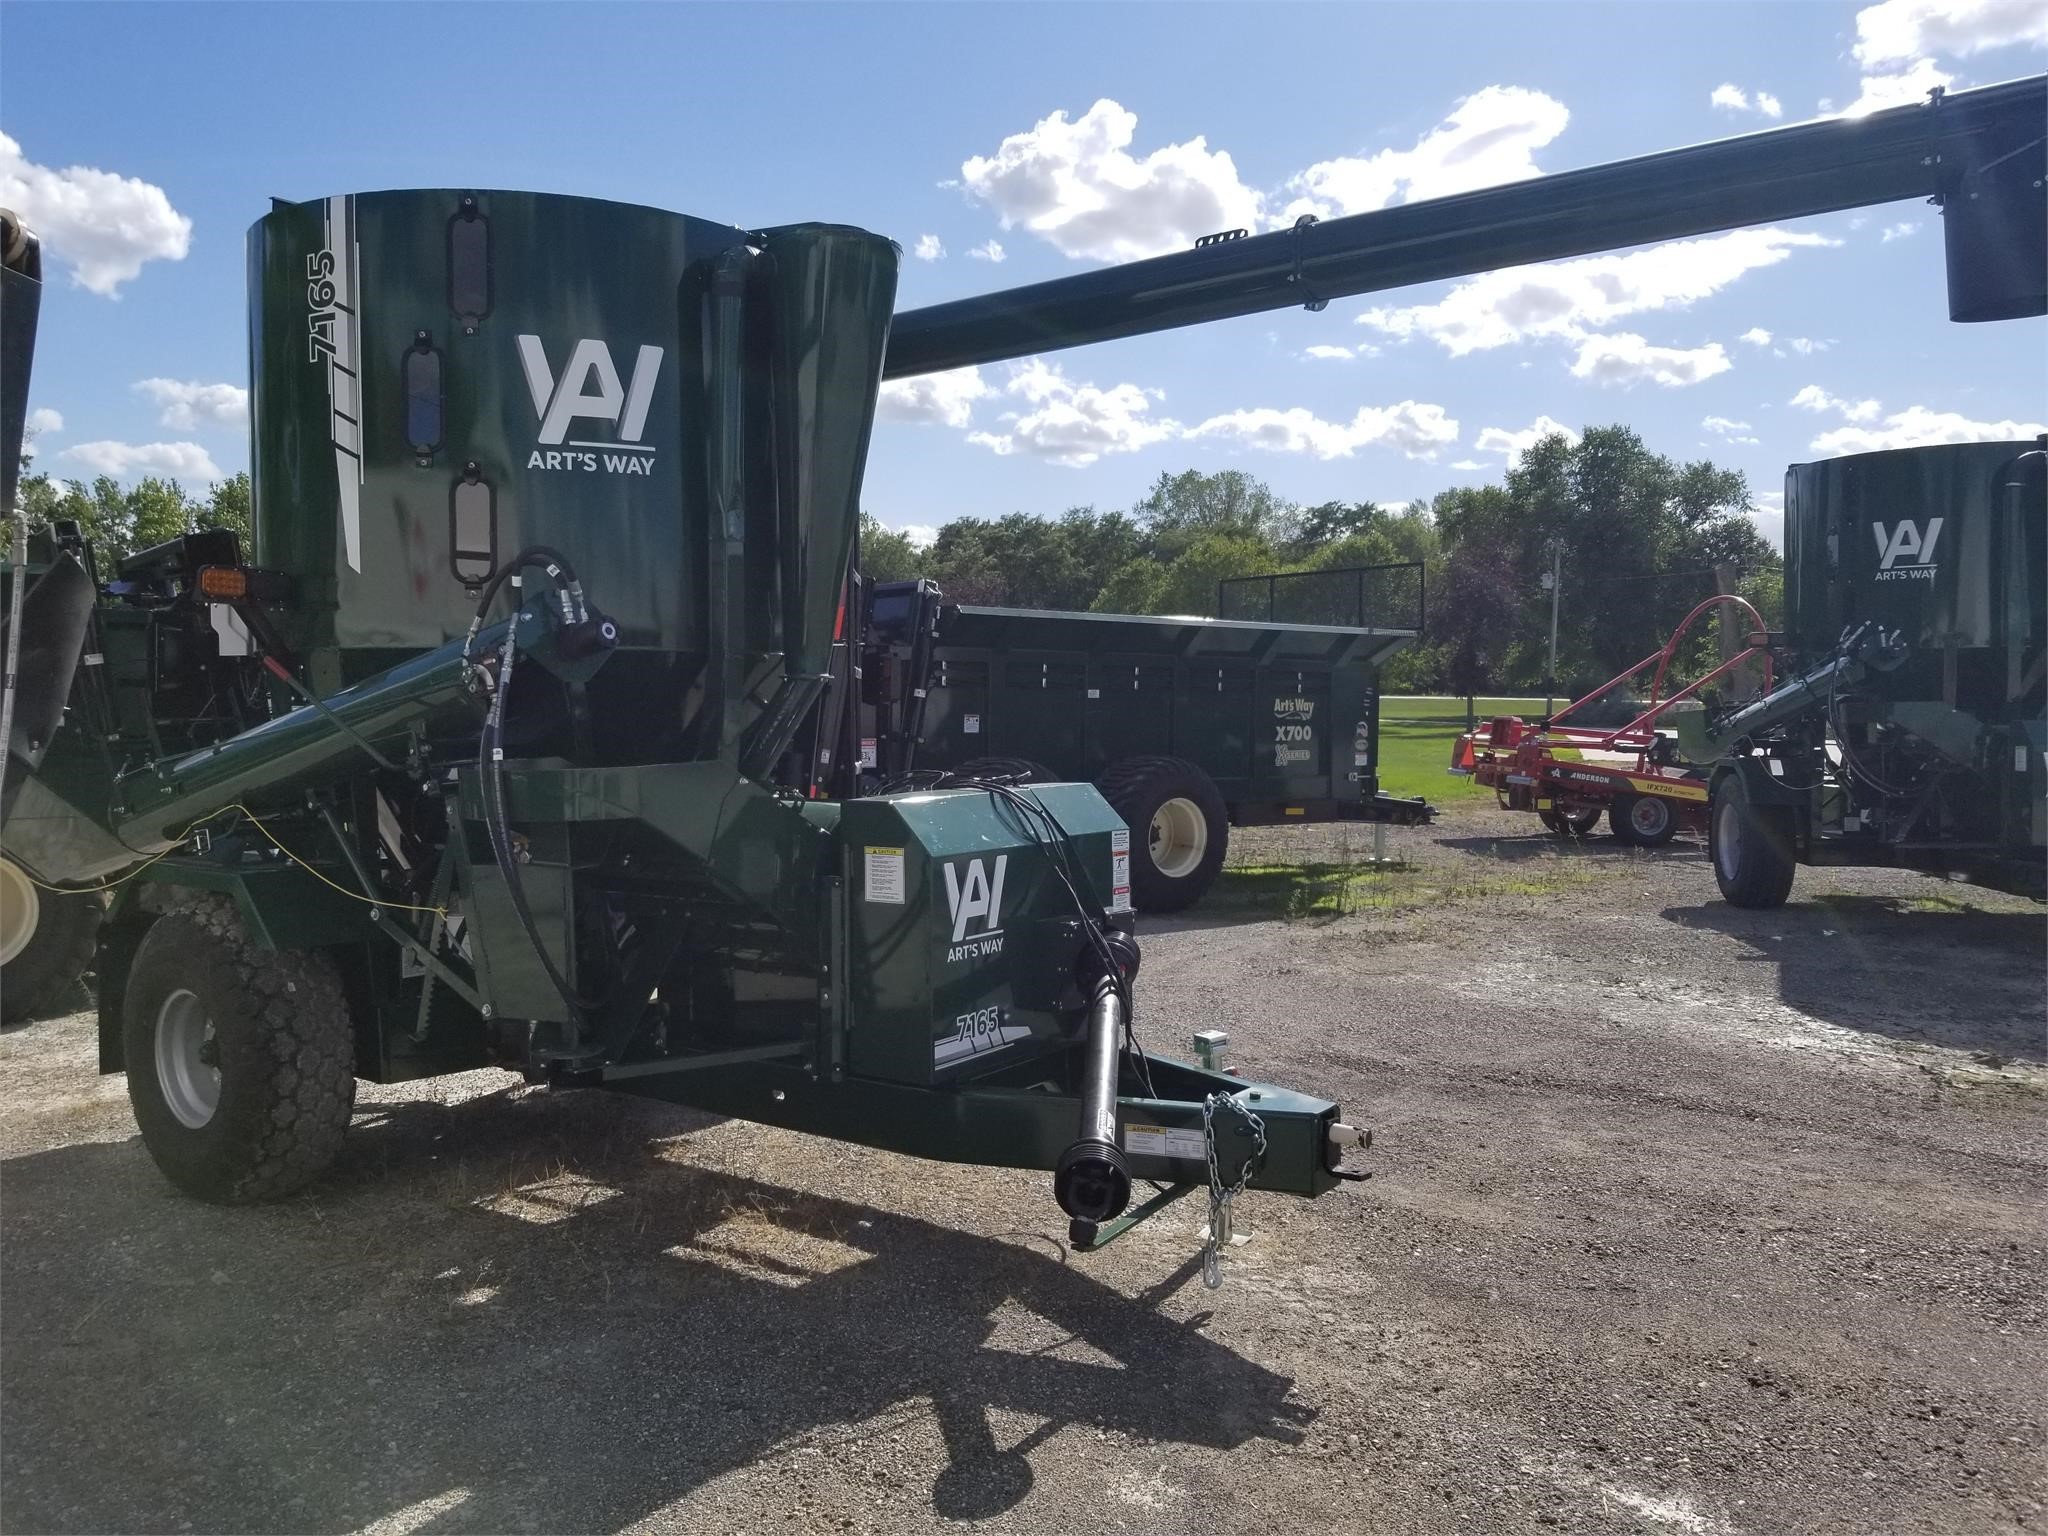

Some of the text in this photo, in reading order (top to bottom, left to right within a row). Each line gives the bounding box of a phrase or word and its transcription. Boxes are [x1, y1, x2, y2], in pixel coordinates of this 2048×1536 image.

[307, 249, 337, 363] 7165
[527, 451, 655, 476] ART'S WAY
[1875, 569, 1937, 581] ART'S WAY
[1295, 698, 1314, 716] Way
[1276, 725, 1312, 741] X700
[1570, 772, 1610, 784] ANDERSON
[1646, 783, 1673, 793] IFX720
[947, 937, 1004, 963] ART'S WAY
[957, 1006, 999, 1042] 7165
